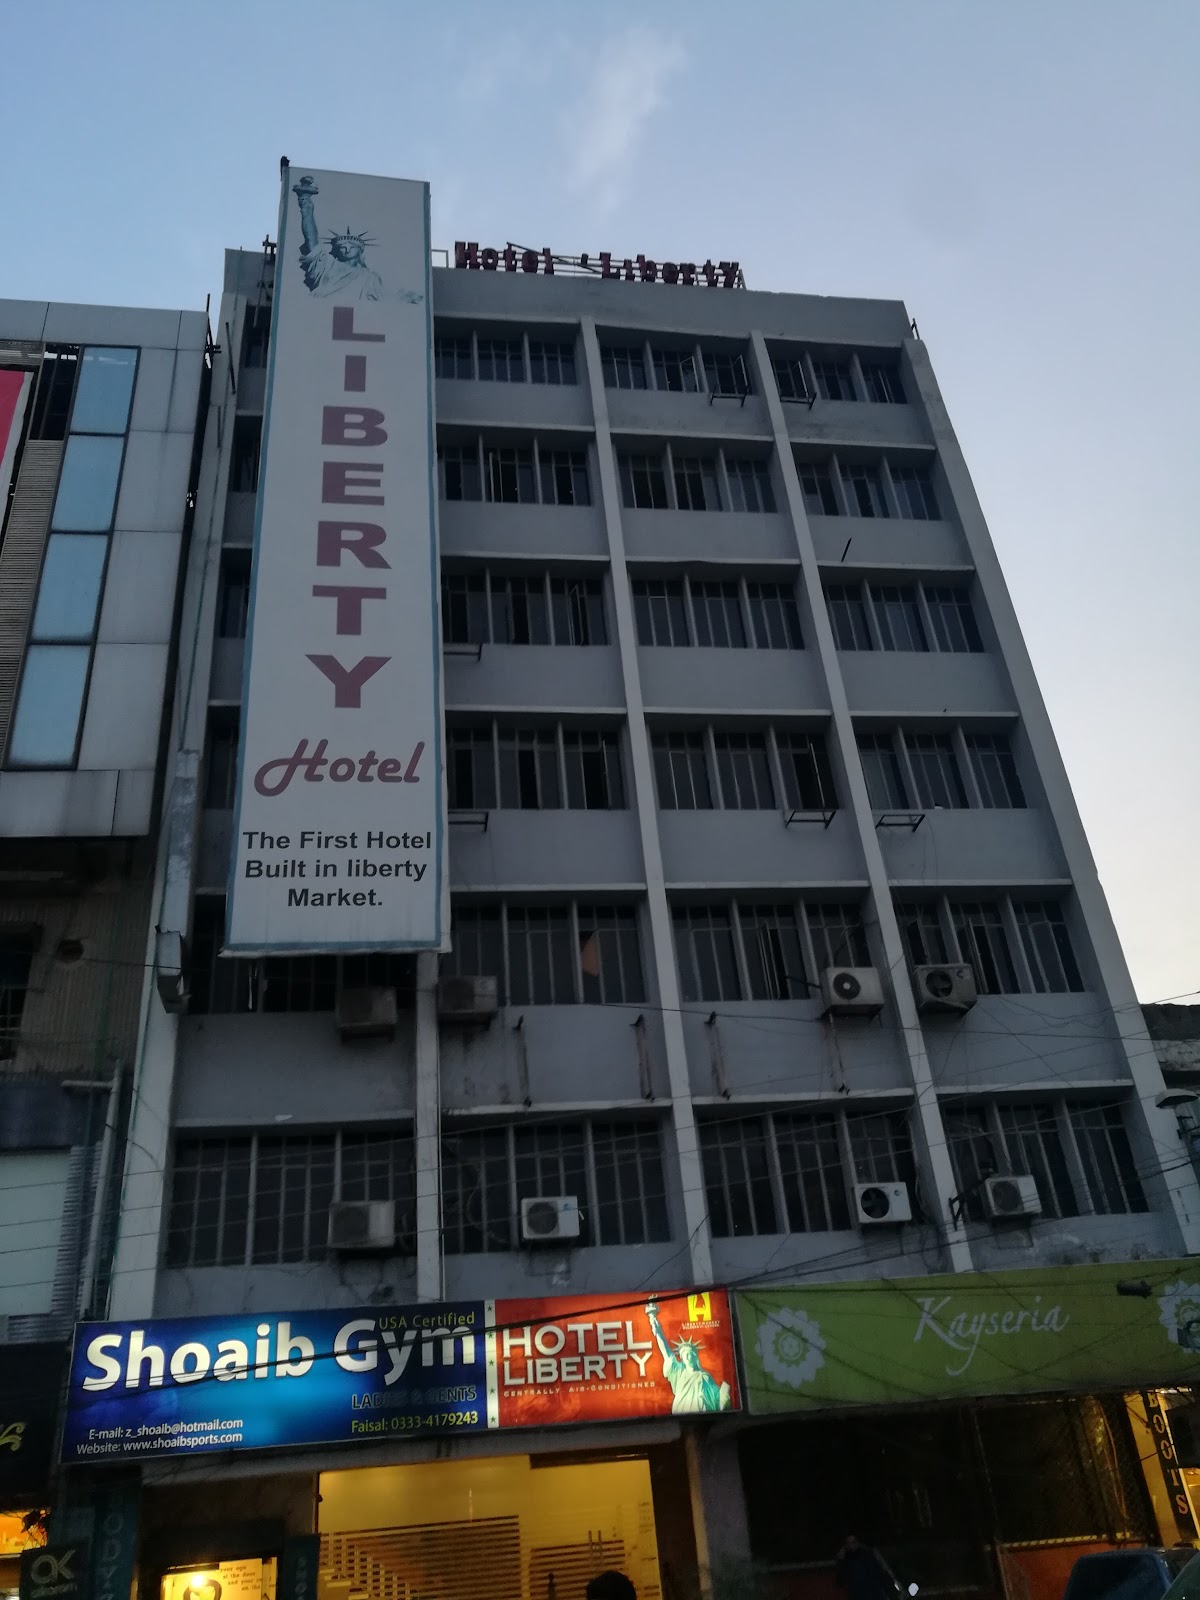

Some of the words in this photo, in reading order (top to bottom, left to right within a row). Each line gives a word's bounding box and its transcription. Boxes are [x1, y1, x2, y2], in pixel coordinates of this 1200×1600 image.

[454, 240, 554, 275] Hotel
[599, 251, 741, 288] Liberty
[305, 306, 392, 709] LIBERTY
[254, 738, 425, 797] Hotel
[243, 831, 290, 849] The
[300, 831, 357, 849] First
[366, 831, 431, 849] Hotel
[245, 860, 306, 878] Built
[315, 860, 338, 878] in
[347, 859, 428, 882] liberty
[287, 888, 383, 907] Market.
[379, 1315, 408, 1330] USA
[412, 1311, 476, 1327] Certified
[502, 1320, 653, 1358] HOTEL
[913, 1296, 1070, 1376] Kayseria
[82, 1321, 315, 1392] Shoaib
[333, 1319, 476, 1386] Gym
[502, 1351, 653, 1386] LIBERTY
[503, 1387, 561, 1398] CENTRALLY
[88, 1425, 124, 1441] E-mail:
[125, 1418, 244, 1439] z_shoaib@hotmail.com
[351, 1418, 388, 1434] Faisal:
[391, 1411, 478, 1430] 0333-4179243
[76, 1442, 121, 1456] Website:
[122, 1432, 243, 1452] www.shoaibsports.com
